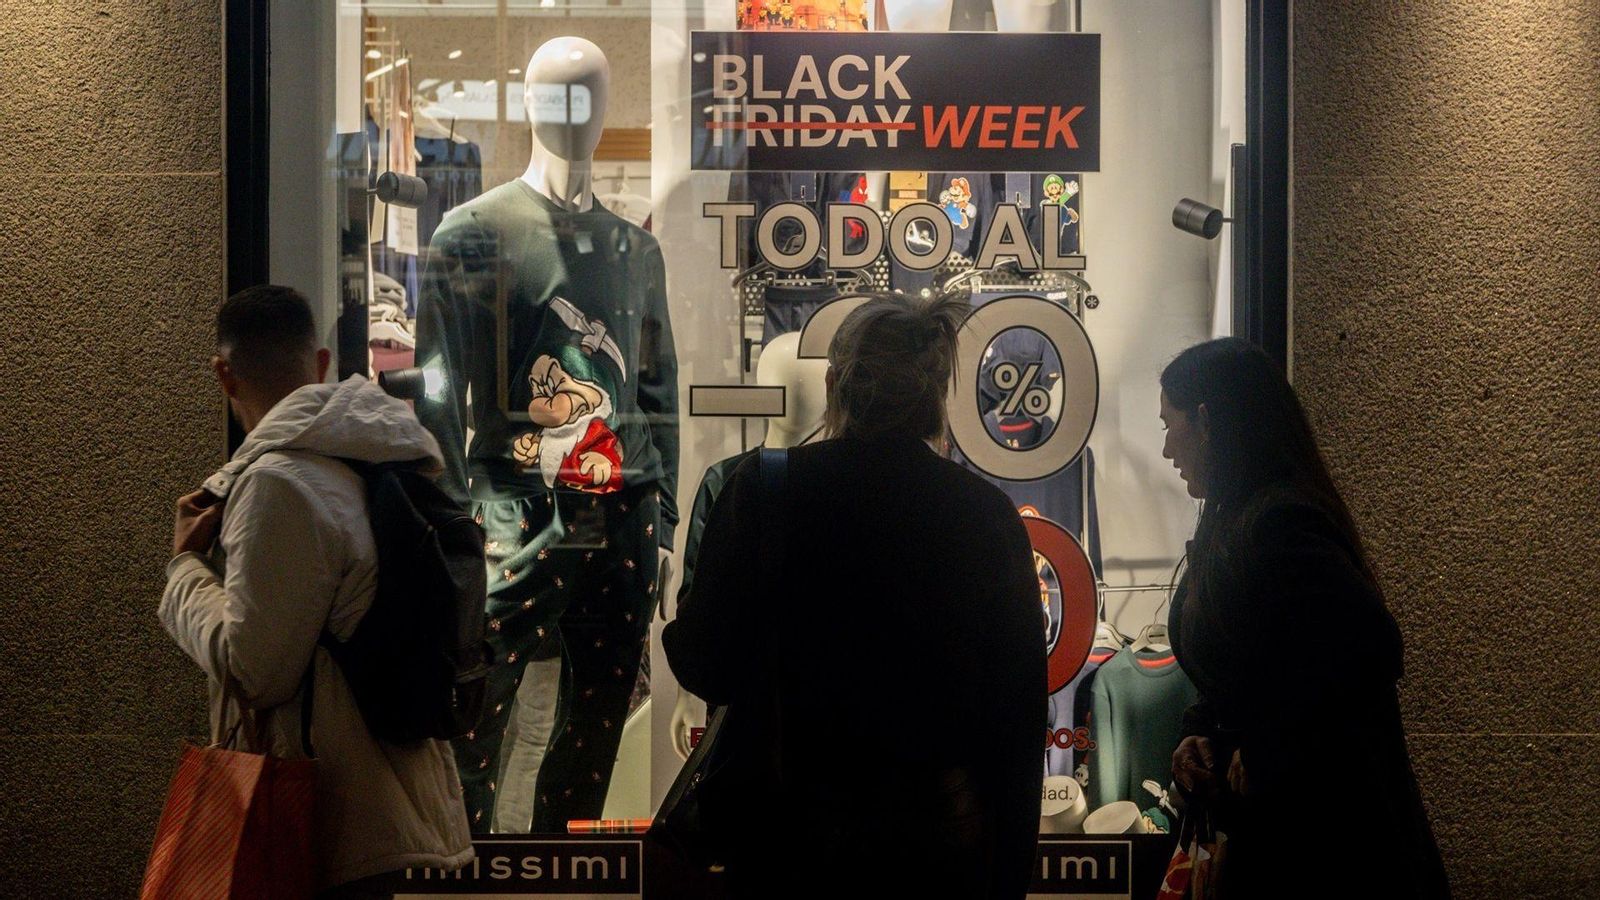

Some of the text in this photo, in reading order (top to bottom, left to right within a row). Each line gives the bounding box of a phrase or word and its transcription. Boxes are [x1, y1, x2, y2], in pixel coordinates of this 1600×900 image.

[713, 54, 912, 99] BLACK
[713, 105, 1086, 149] FRIDAY WEEK
[703, 201, 1086, 270] TODO AL
